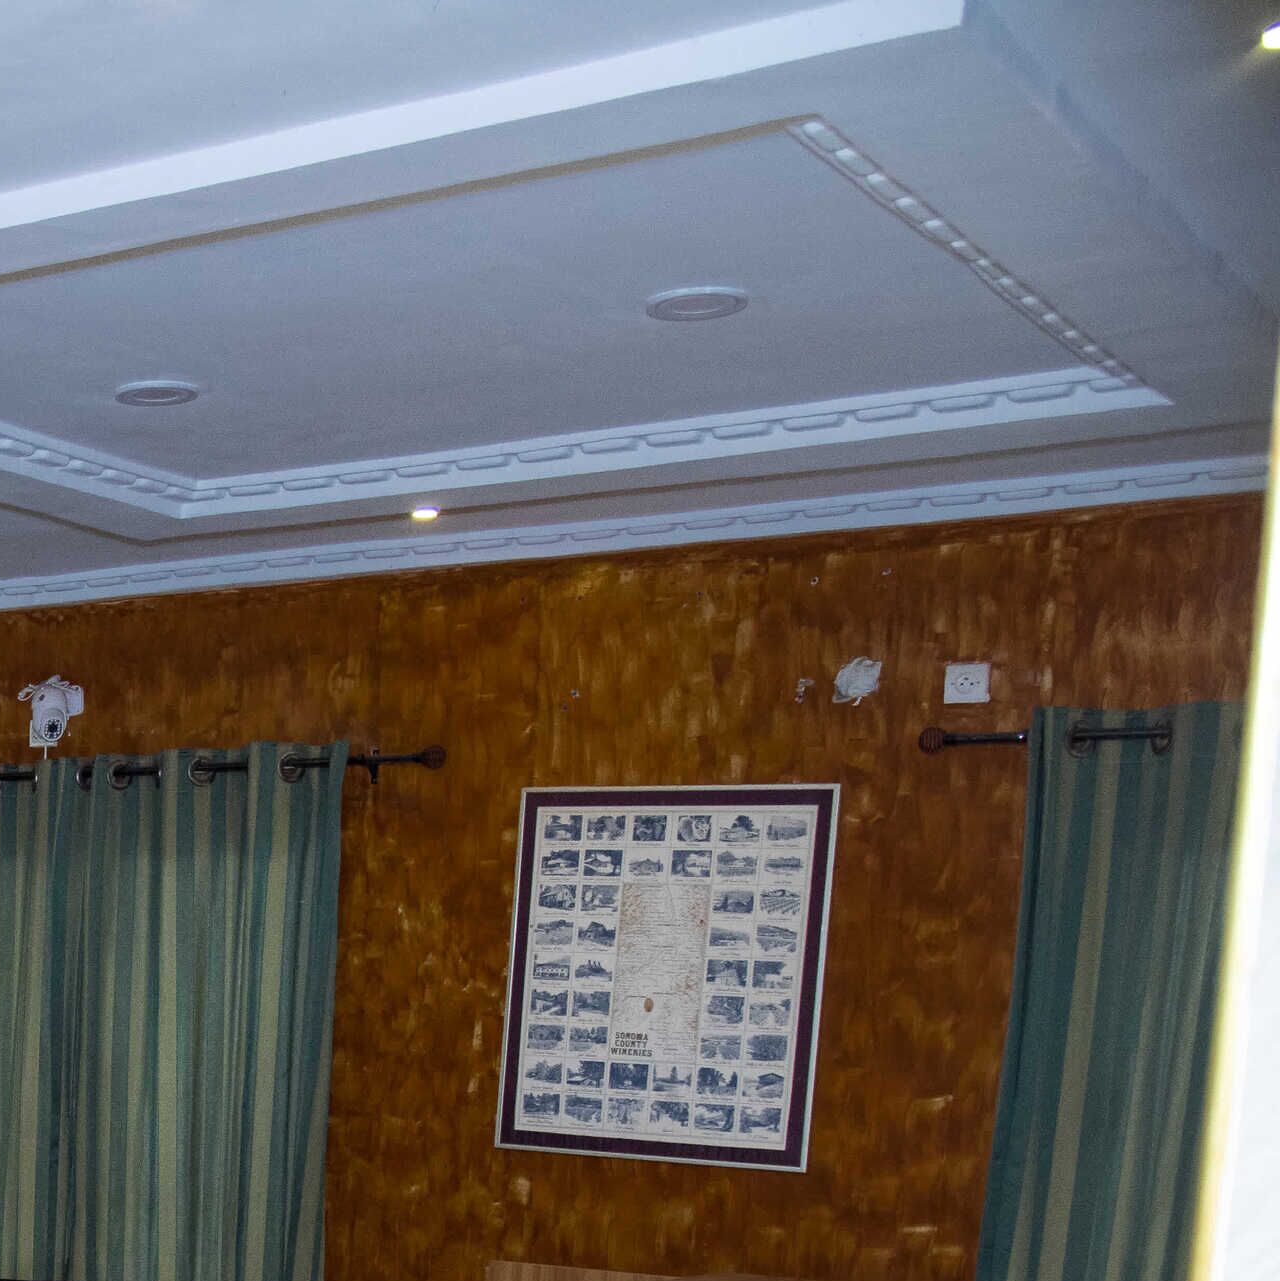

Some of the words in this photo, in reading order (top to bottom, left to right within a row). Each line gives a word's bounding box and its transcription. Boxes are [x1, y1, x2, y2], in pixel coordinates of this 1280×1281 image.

[615, 1031, 648, 1040] SONOMA
[614, 1040, 647, 1048] COUNTY
[610, 1047, 653, 1057] WINERIES
